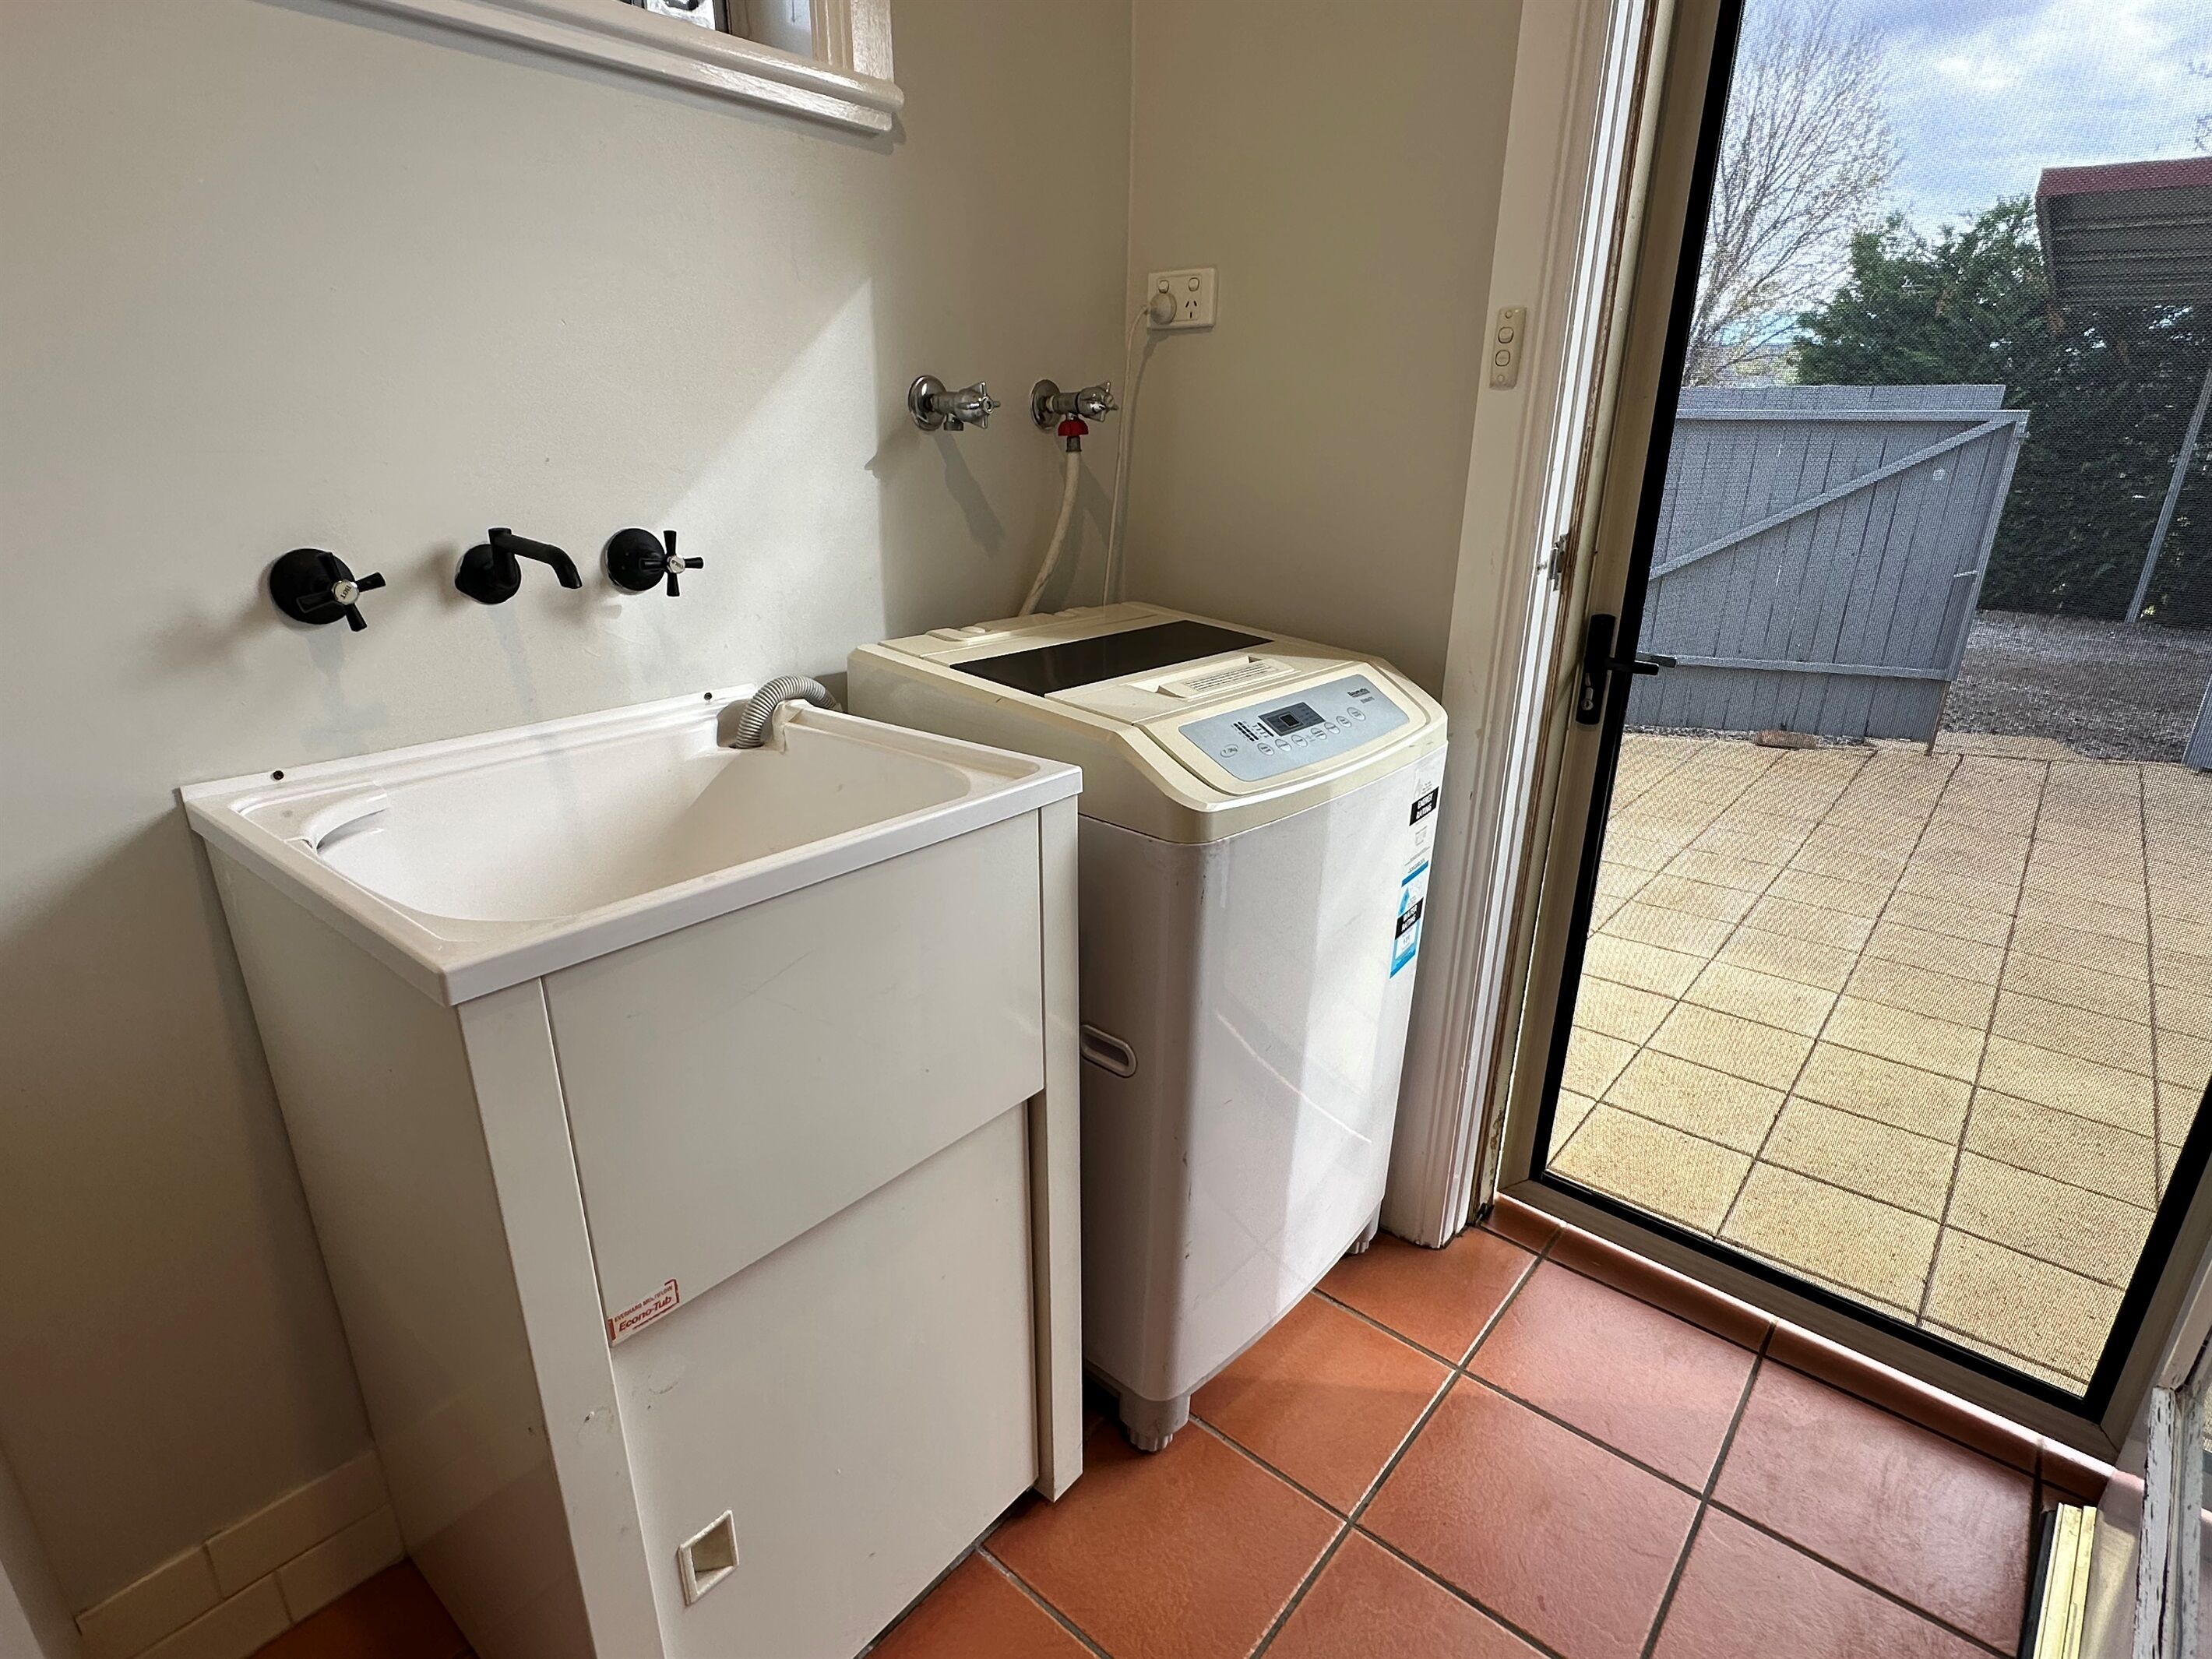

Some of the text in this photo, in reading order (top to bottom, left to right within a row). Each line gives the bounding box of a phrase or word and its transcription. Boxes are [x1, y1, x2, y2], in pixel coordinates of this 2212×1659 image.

[340, 585, 351, 598] HOT
[1415, 802, 1432, 819] RATING
[1403, 904, 1418, 922] WATER
[1400, 914, 1417, 932] RATING
[619, 1296, 672, 1332] Econo-Tub
